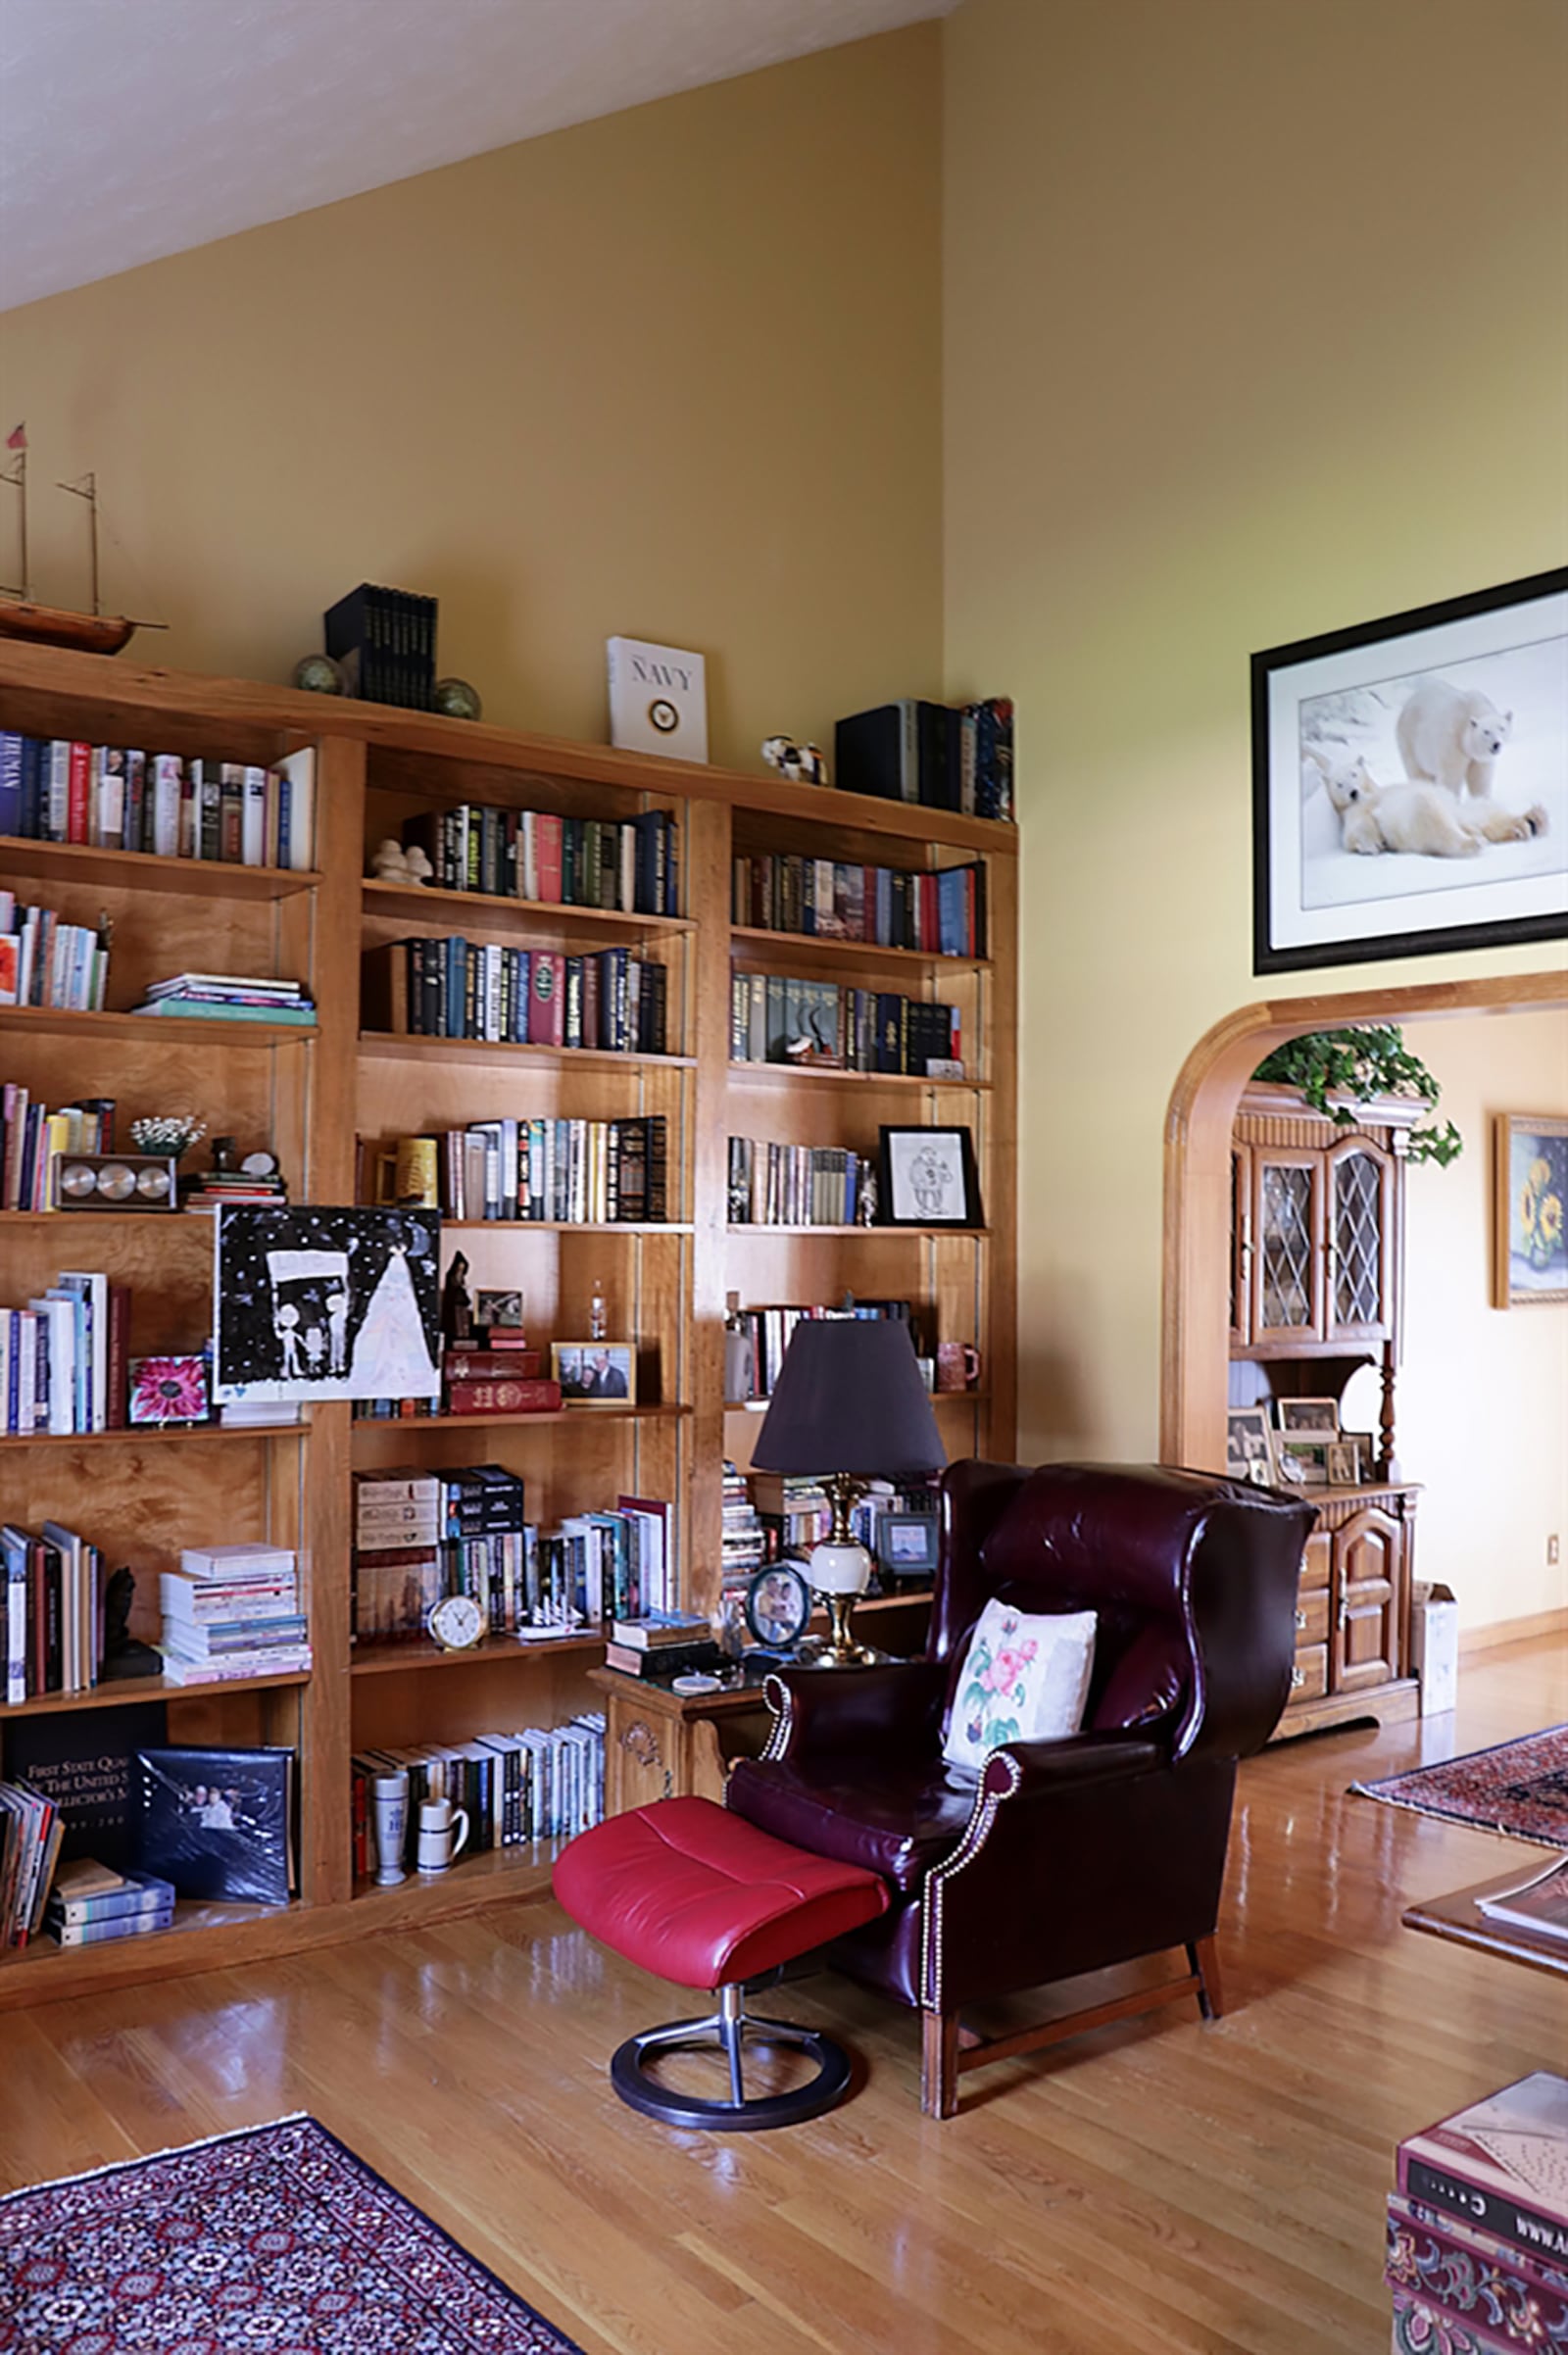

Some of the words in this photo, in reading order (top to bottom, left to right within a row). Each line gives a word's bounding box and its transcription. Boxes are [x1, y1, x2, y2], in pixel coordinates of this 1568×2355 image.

[631, 657, 693, 691] NAVY
[3, 735, 23, 790] TRUMAN
[27, 1764, 59, 1779] FIRST
[62, 1760, 94, 1775] STATE
[45, 1779, 71, 1792] THE
[74, 1773, 121, 1790] UNITED
